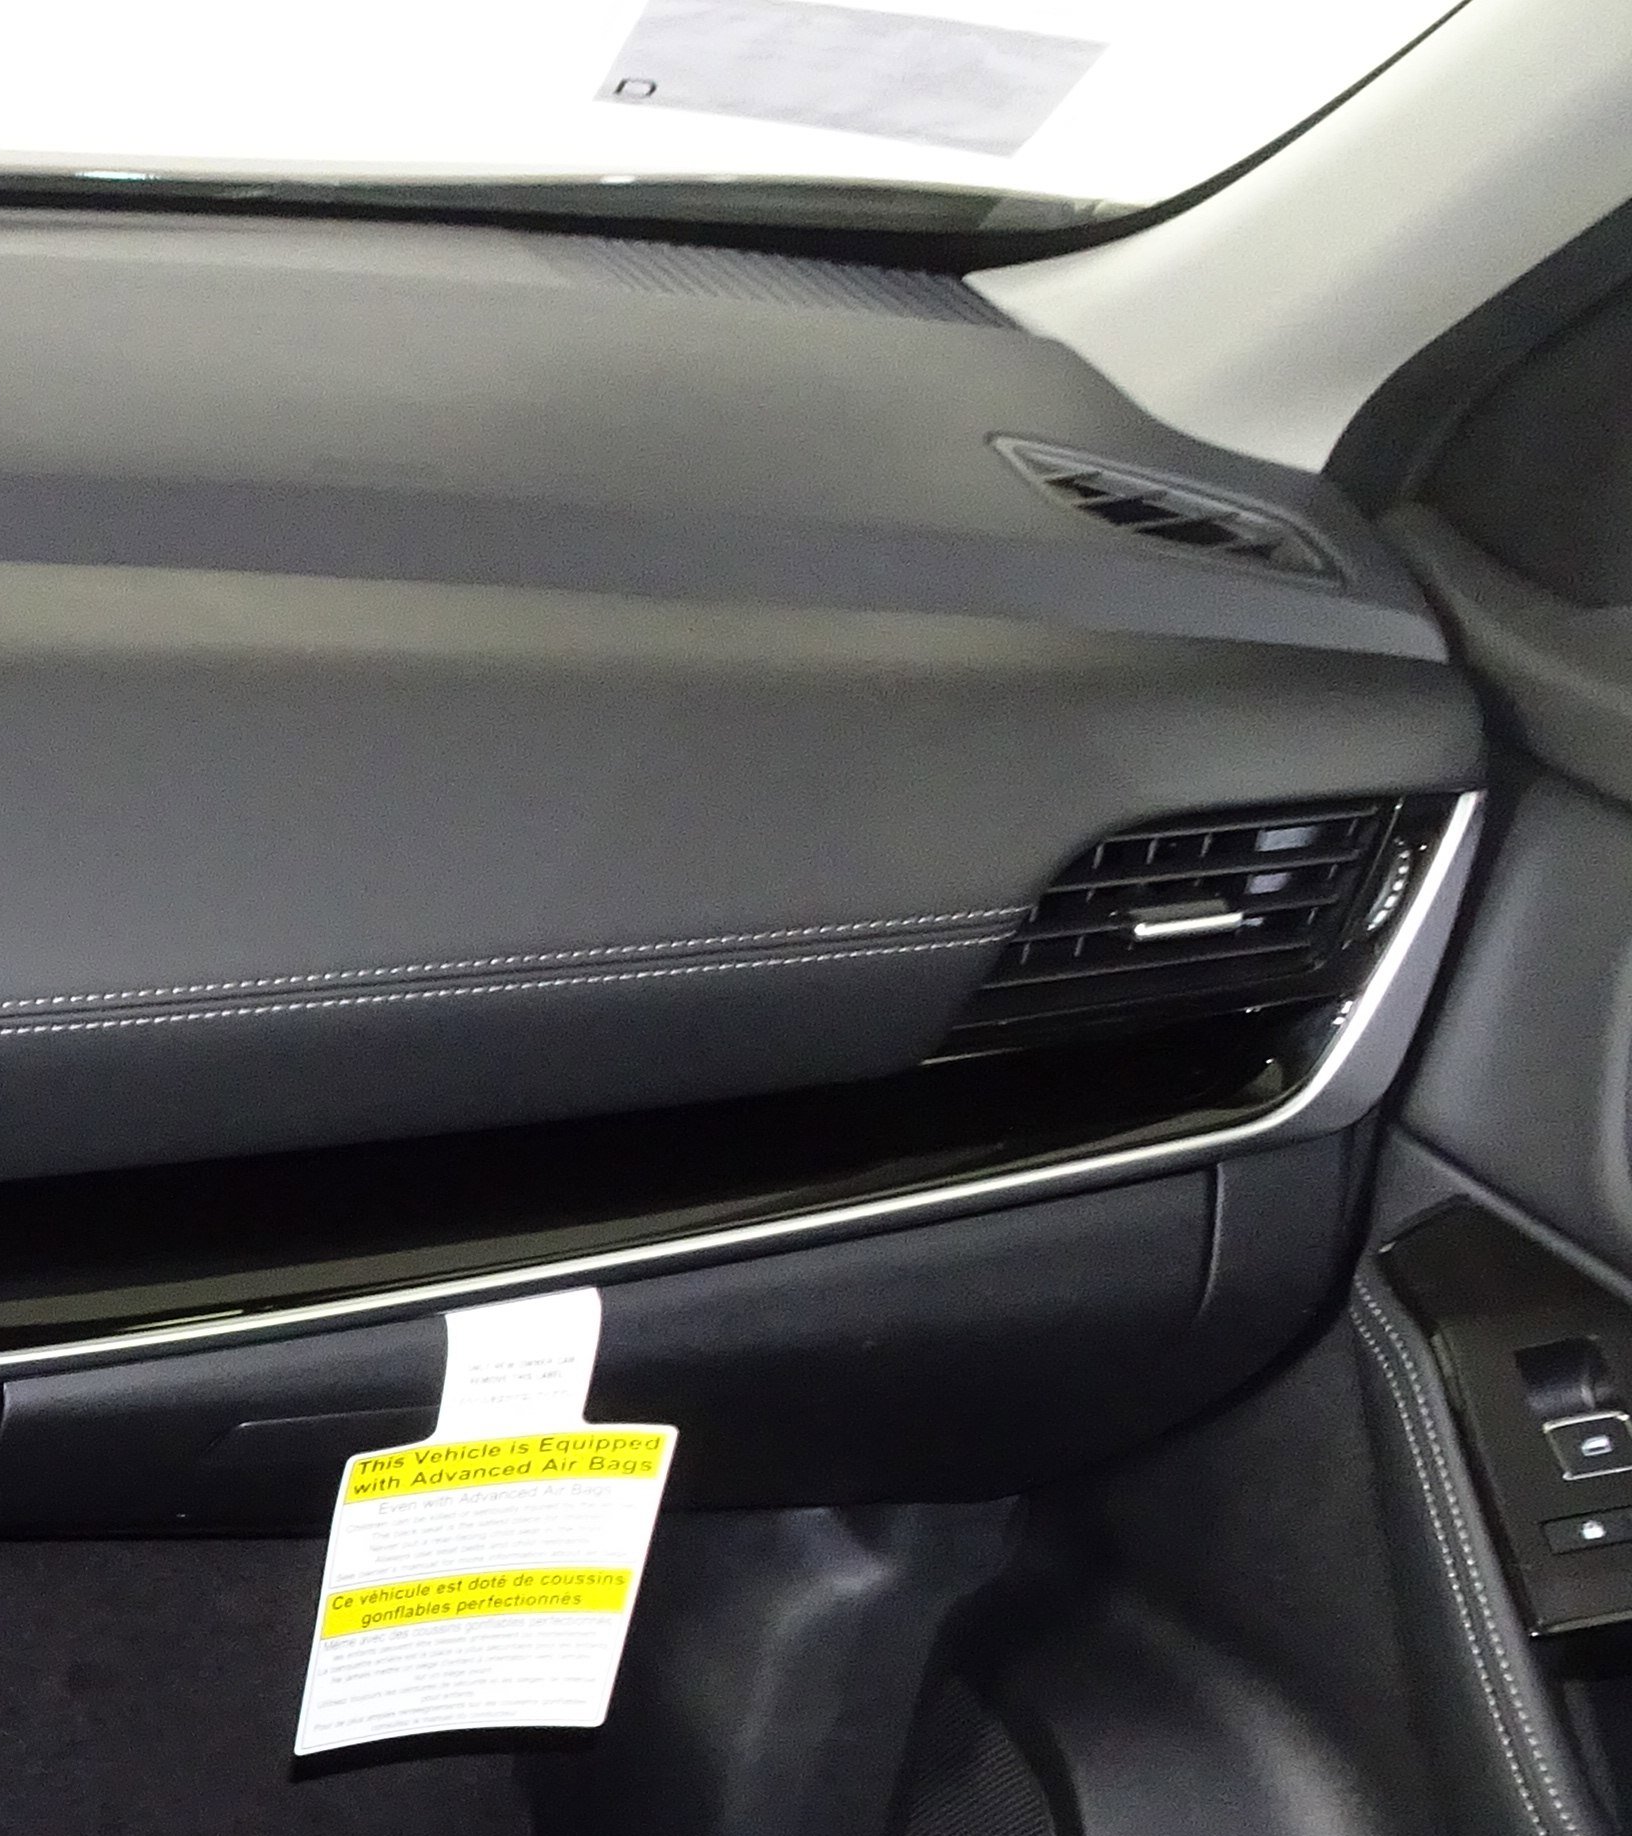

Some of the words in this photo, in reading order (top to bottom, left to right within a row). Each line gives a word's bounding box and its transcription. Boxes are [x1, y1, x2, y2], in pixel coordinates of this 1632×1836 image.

[359, 1455, 405, 1475] This
[415, 1444, 501, 1465] Vehicle
[510, 1441, 529, 1454] is
[539, 1436, 661, 1453] Equipped
[354, 1477, 401, 1494] with
[410, 1462, 531, 1486] Advanced
[542, 1458, 578, 1472] Air
[588, 1456, 653, 1474] Bags
[378, 1501, 417, 1515] Even
[423, 1495, 453, 1509] with
[459, 1486, 538, 1504] Advanced
[544, 1485, 565, 1495] Air
[332, 1596, 353, 1610] Ce
[360, 1583, 430, 1606] véhicule
[436, 1581, 462, 1594] est
[468, 1575, 506, 1591] doté
[513, 1573, 534, 1586] de
[540, 1573, 625, 1586] coussins
[361, 1603, 451, 1628] gonflables
[456, 1592, 581, 1616] perfectionnés
